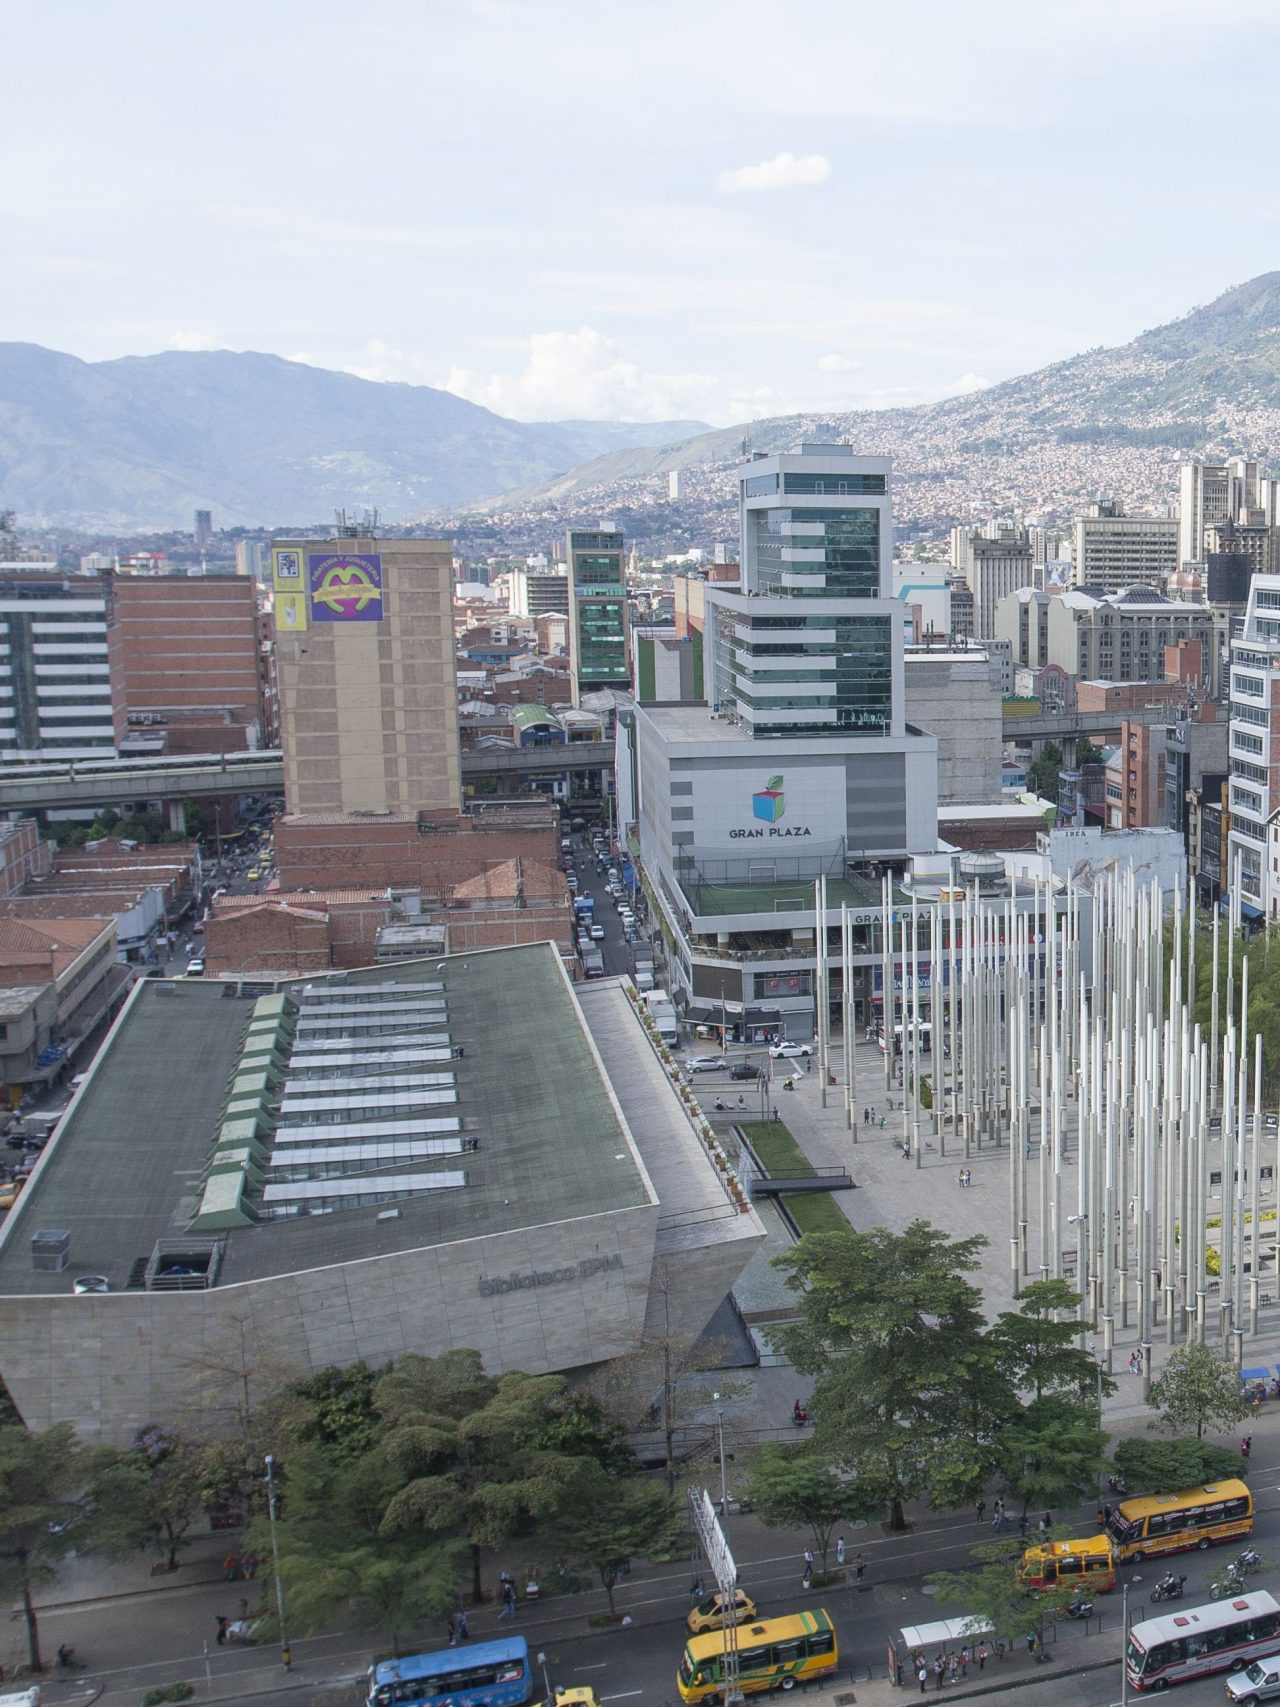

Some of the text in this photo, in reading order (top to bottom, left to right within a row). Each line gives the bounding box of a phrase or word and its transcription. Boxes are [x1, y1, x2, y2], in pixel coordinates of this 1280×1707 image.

[729, 826, 812, 838] GRAN PLAZA
[479, 1253, 623, 1297] Biblioteca EPM
